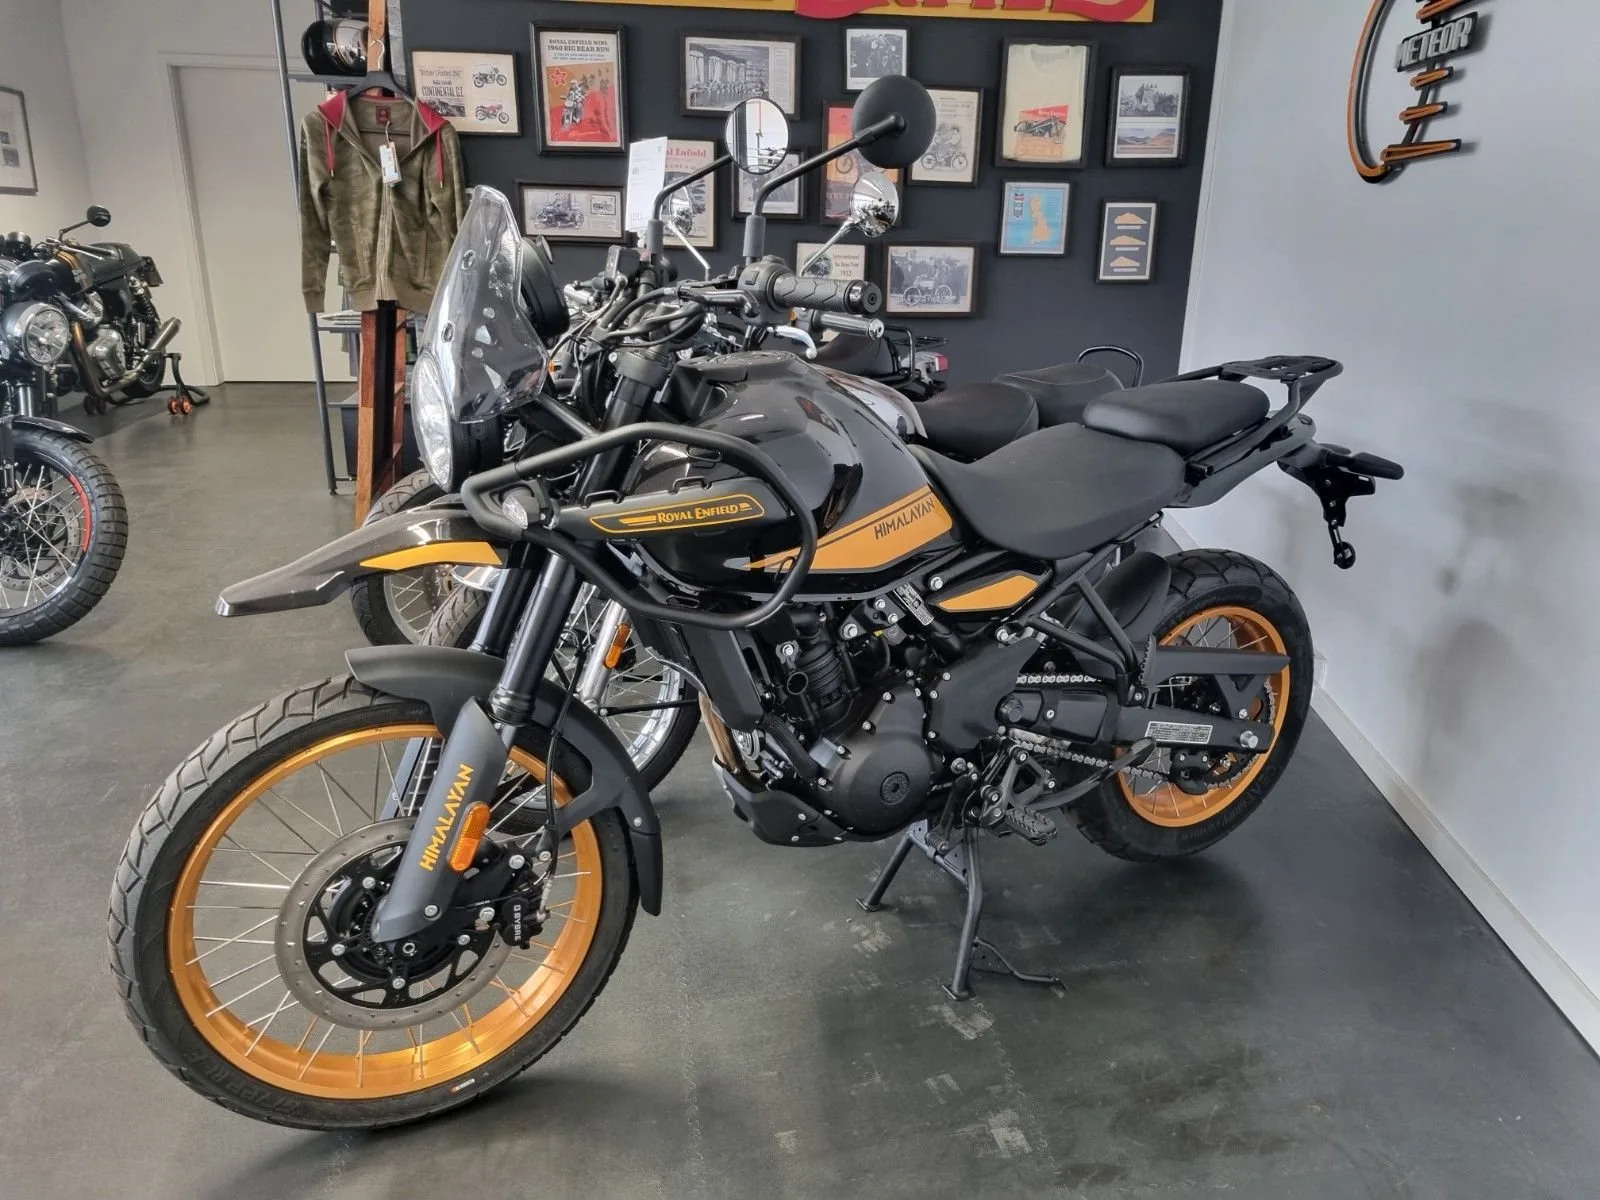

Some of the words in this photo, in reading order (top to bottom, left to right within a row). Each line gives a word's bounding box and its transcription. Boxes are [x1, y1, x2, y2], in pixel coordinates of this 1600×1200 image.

[1395, 17, 1473, 69] METEOR
[675, 148, 707, 158] Enfield
[657, 510, 693, 523] ROYAL
[695, 504, 739, 520] ENFIELD
[874, 496, 936, 540] HIMALAYAN
[420, 763, 474, 872] HIMALAYAN
